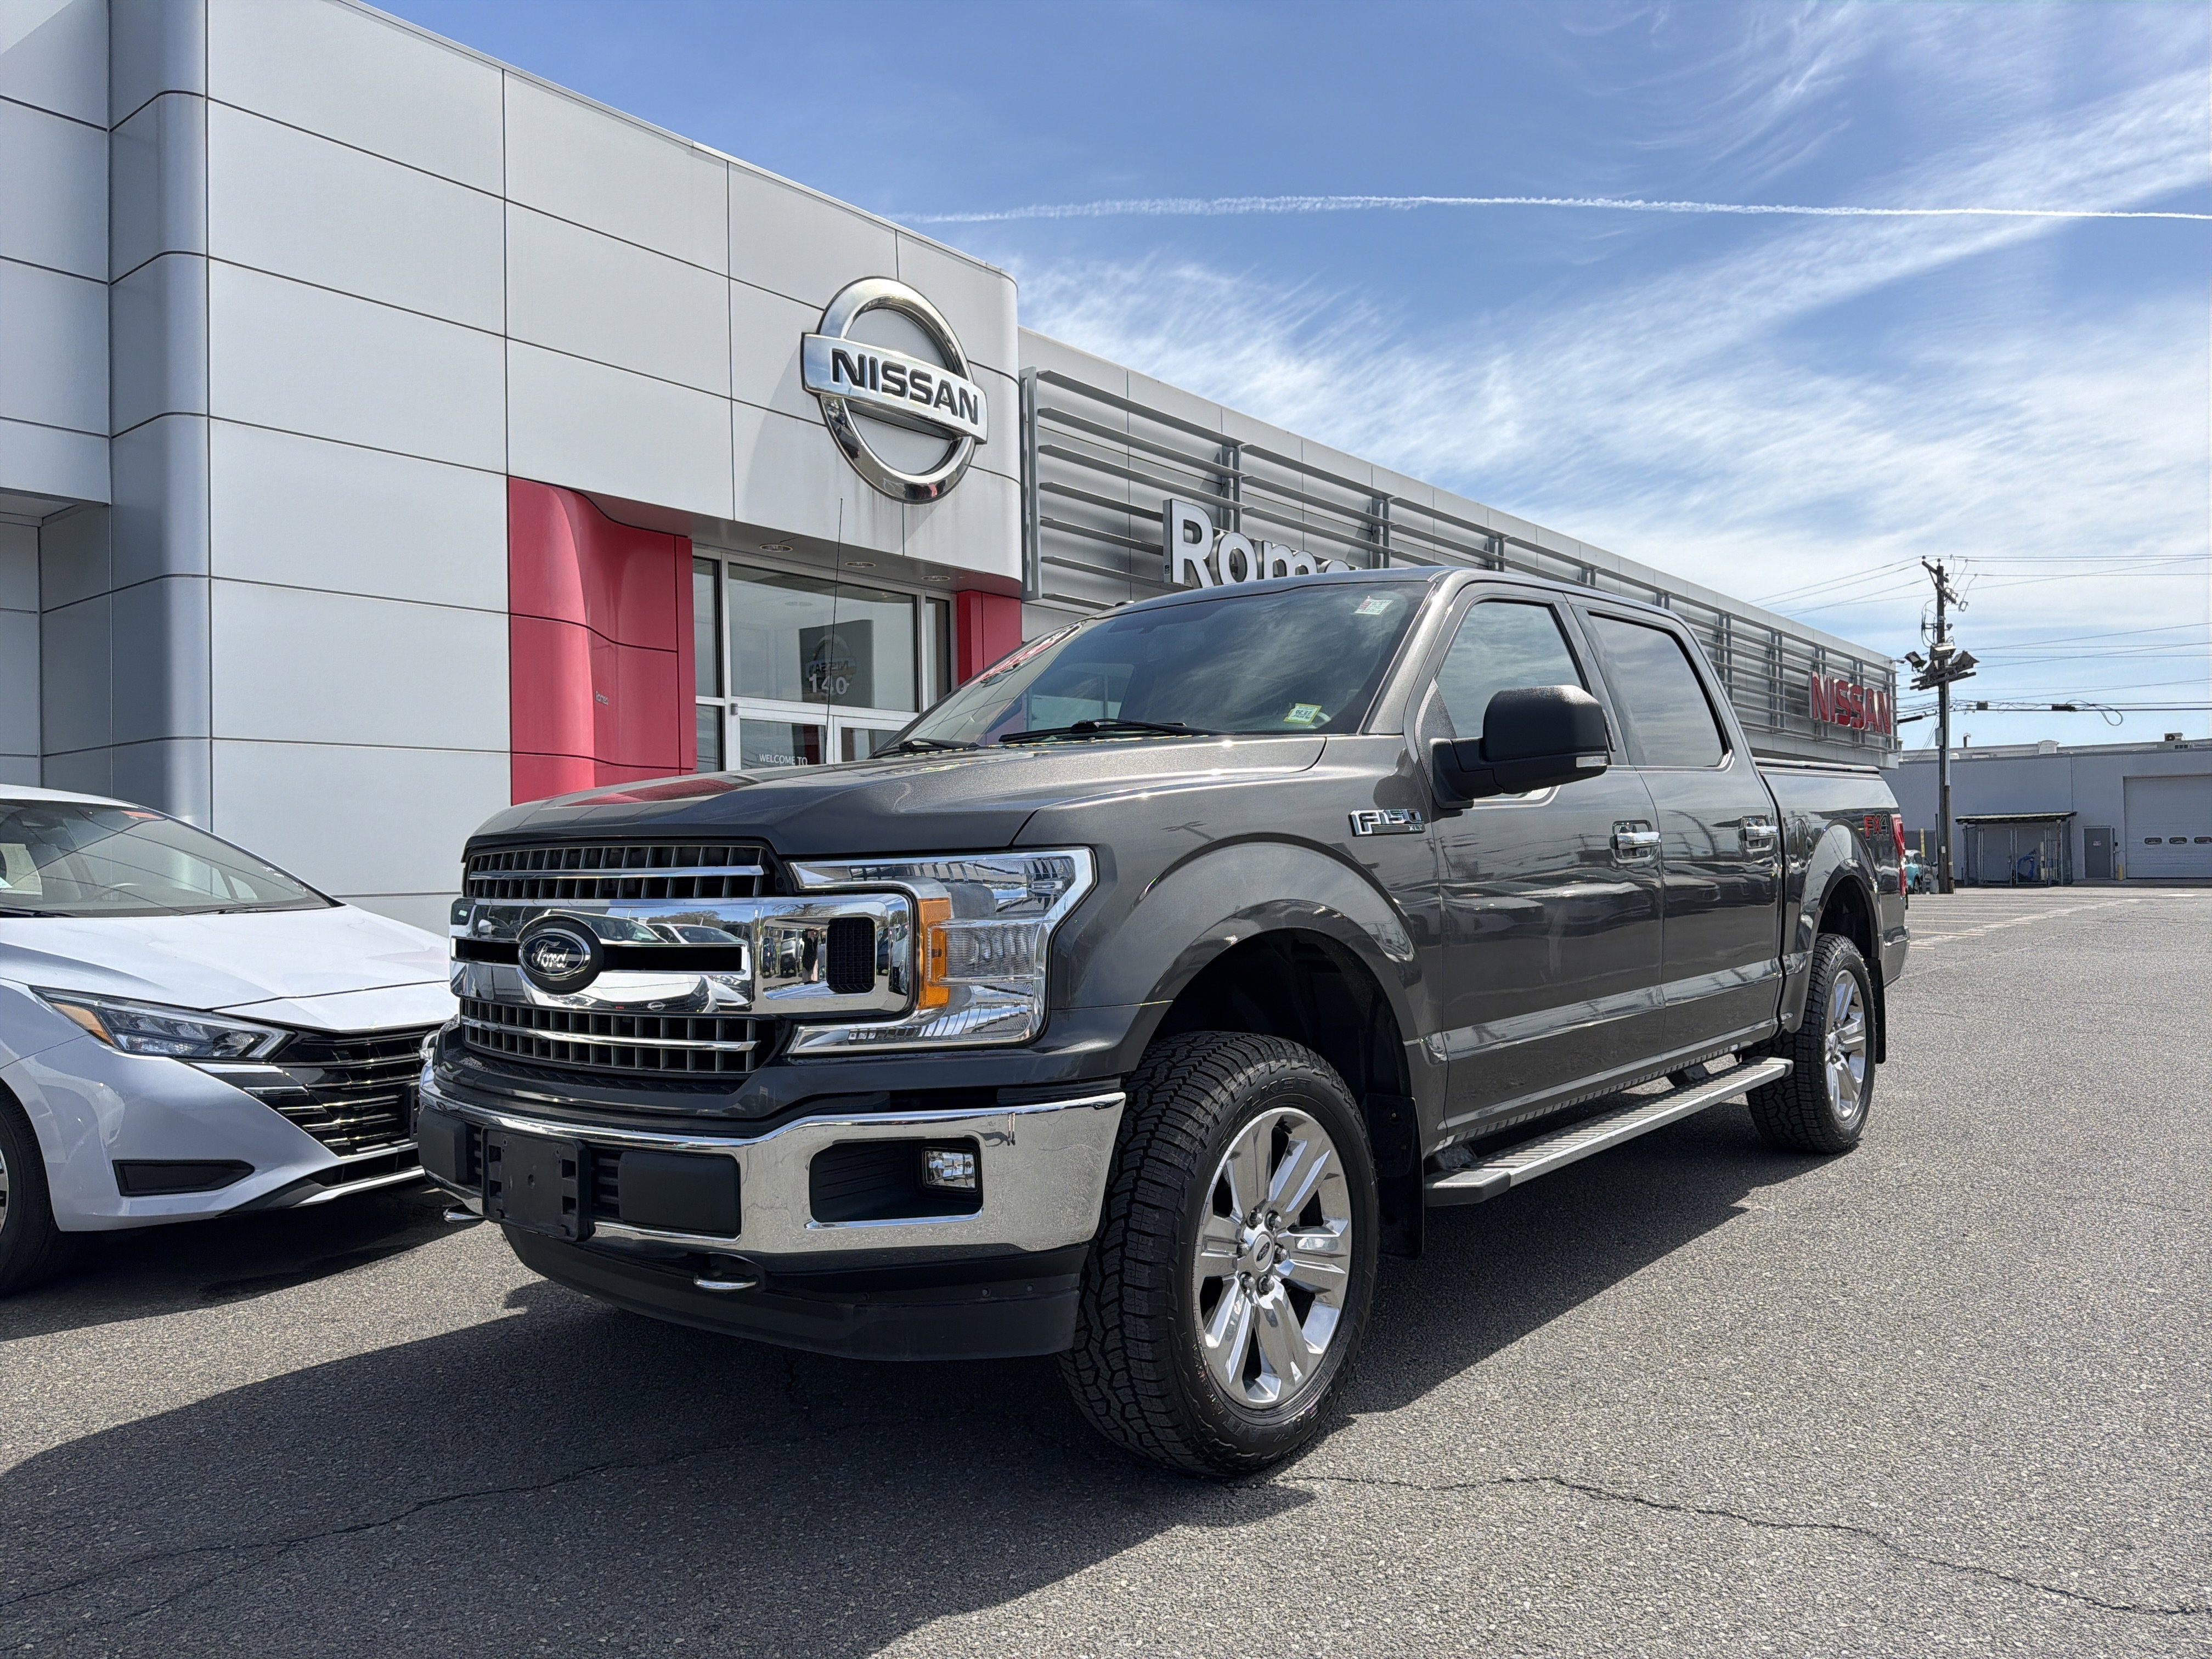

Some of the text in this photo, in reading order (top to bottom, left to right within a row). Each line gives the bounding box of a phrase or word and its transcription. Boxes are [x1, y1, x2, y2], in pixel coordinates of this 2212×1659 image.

[832, 348, 979, 425] NISSAN
[809, 673, 848, 695] 140
[1810, 672, 1892, 736] NISSAN
[759, 754, 808, 765] WELCOME TO
[1863, 814, 1889, 840] FX4
[531, 939, 569, 968] Ford
